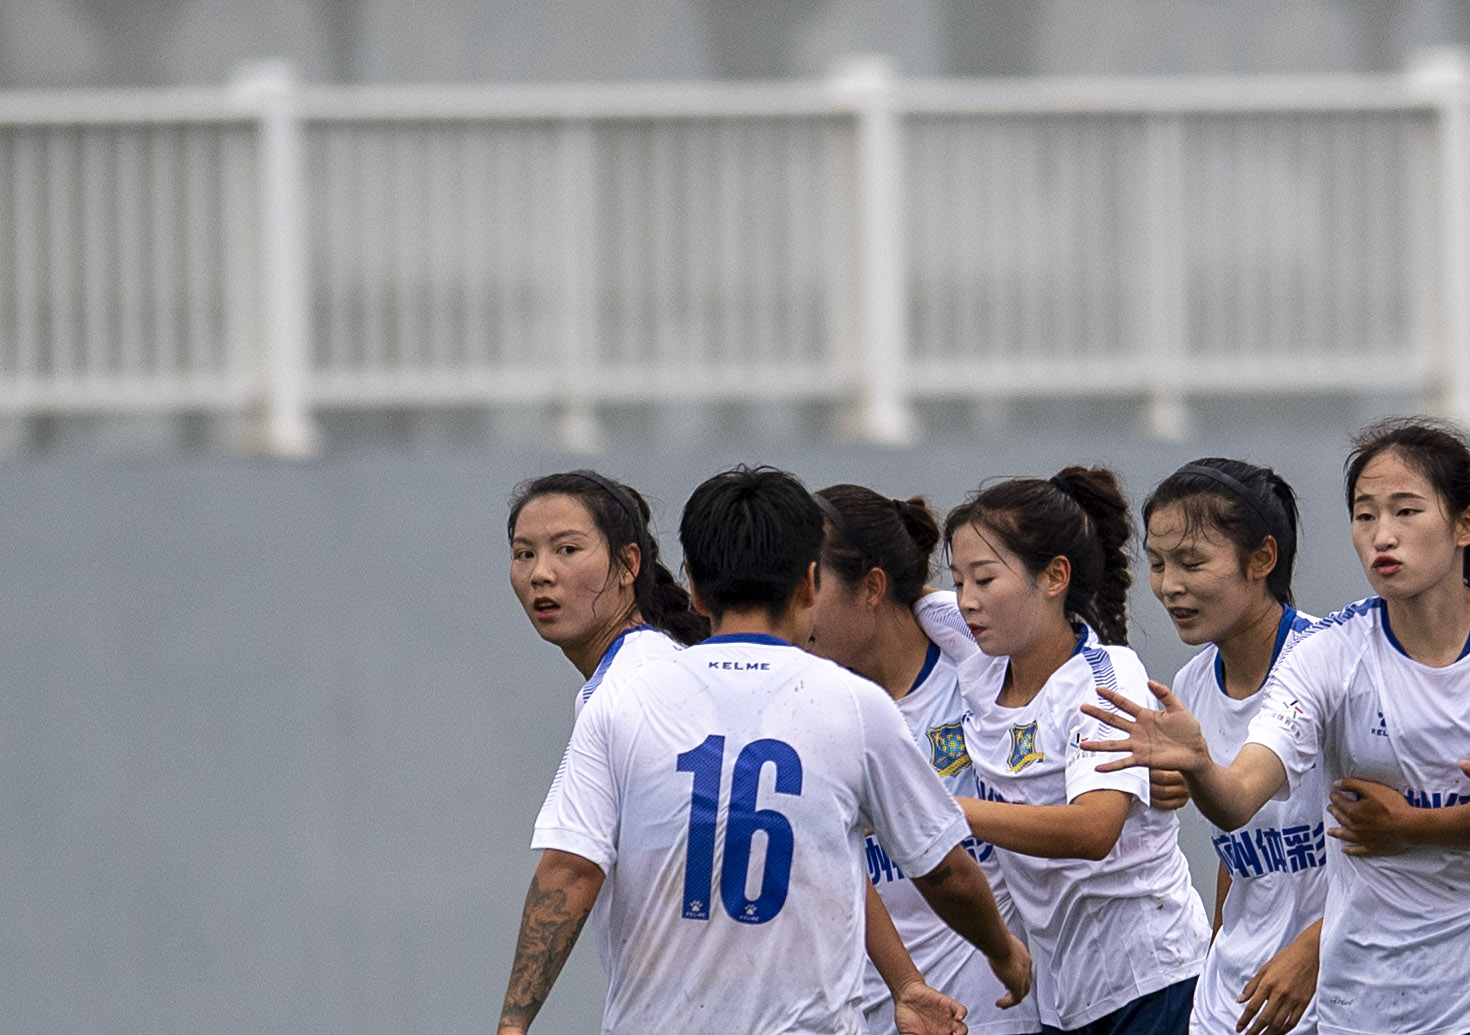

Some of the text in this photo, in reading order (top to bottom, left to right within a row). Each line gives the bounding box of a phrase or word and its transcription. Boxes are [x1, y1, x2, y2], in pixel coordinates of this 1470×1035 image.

[708, 661, 770, 670] KELME
[1371, 728, 1388, 737] KEL
[676, 734, 803, 925] 16
